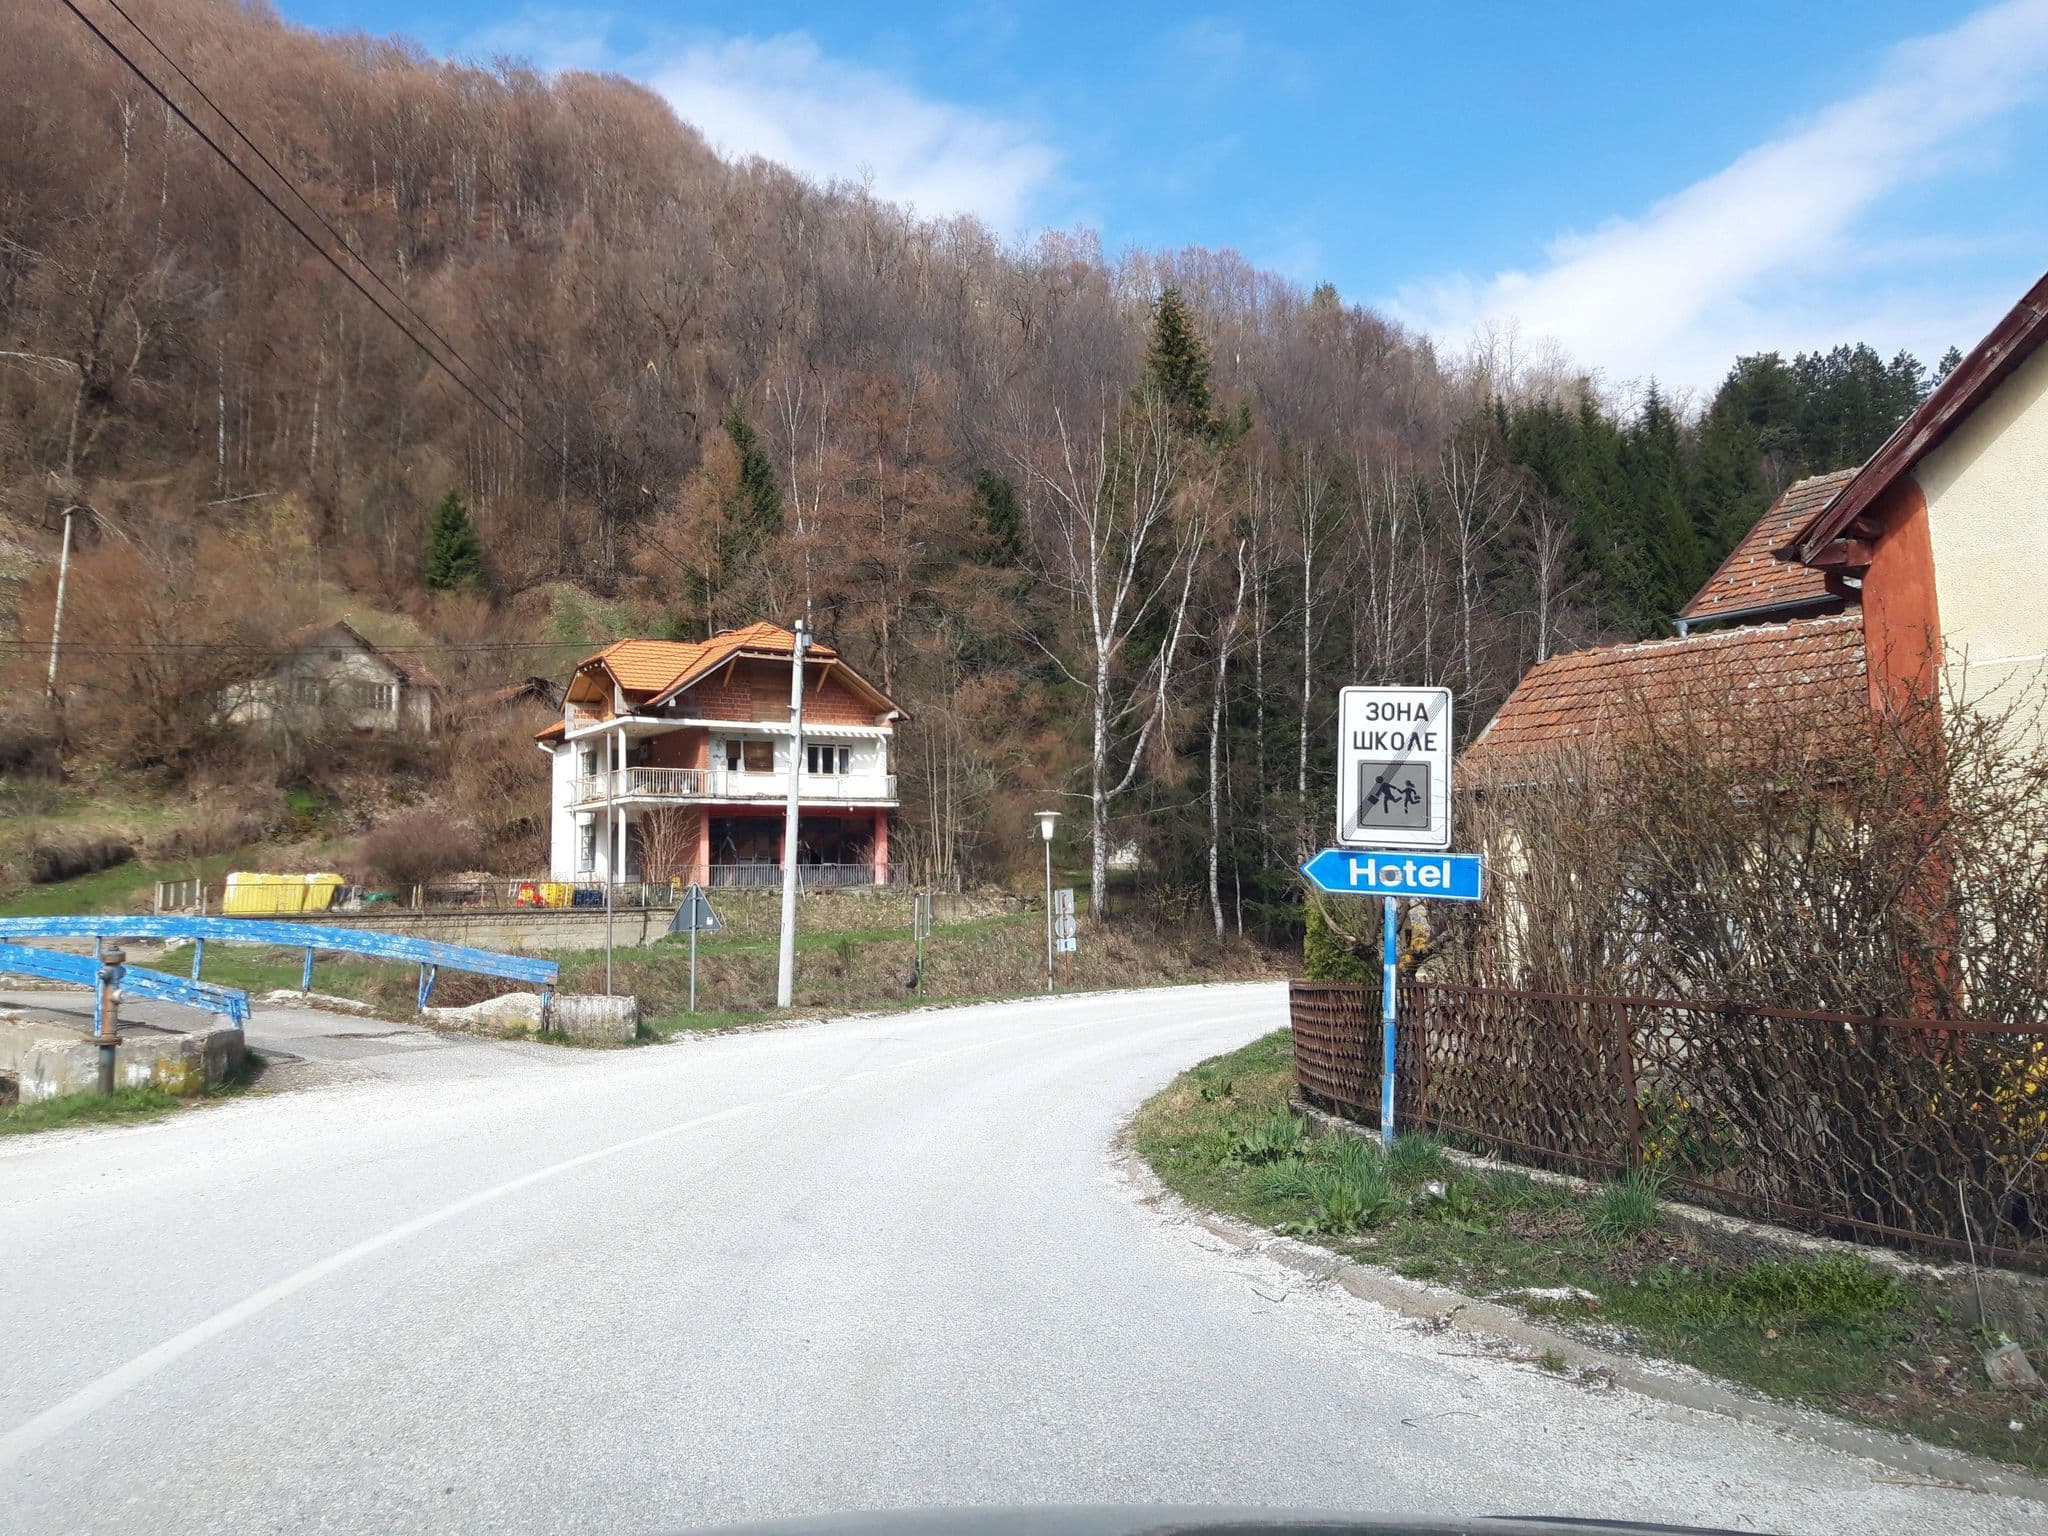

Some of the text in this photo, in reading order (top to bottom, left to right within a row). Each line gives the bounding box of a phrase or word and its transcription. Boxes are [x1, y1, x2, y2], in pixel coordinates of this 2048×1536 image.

[1366, 702, 1429, 722] ЗОНА
[1353, 731, 1437, 751] ШКОЛЕ
[1349, 858, 1451, 889] Hotel
